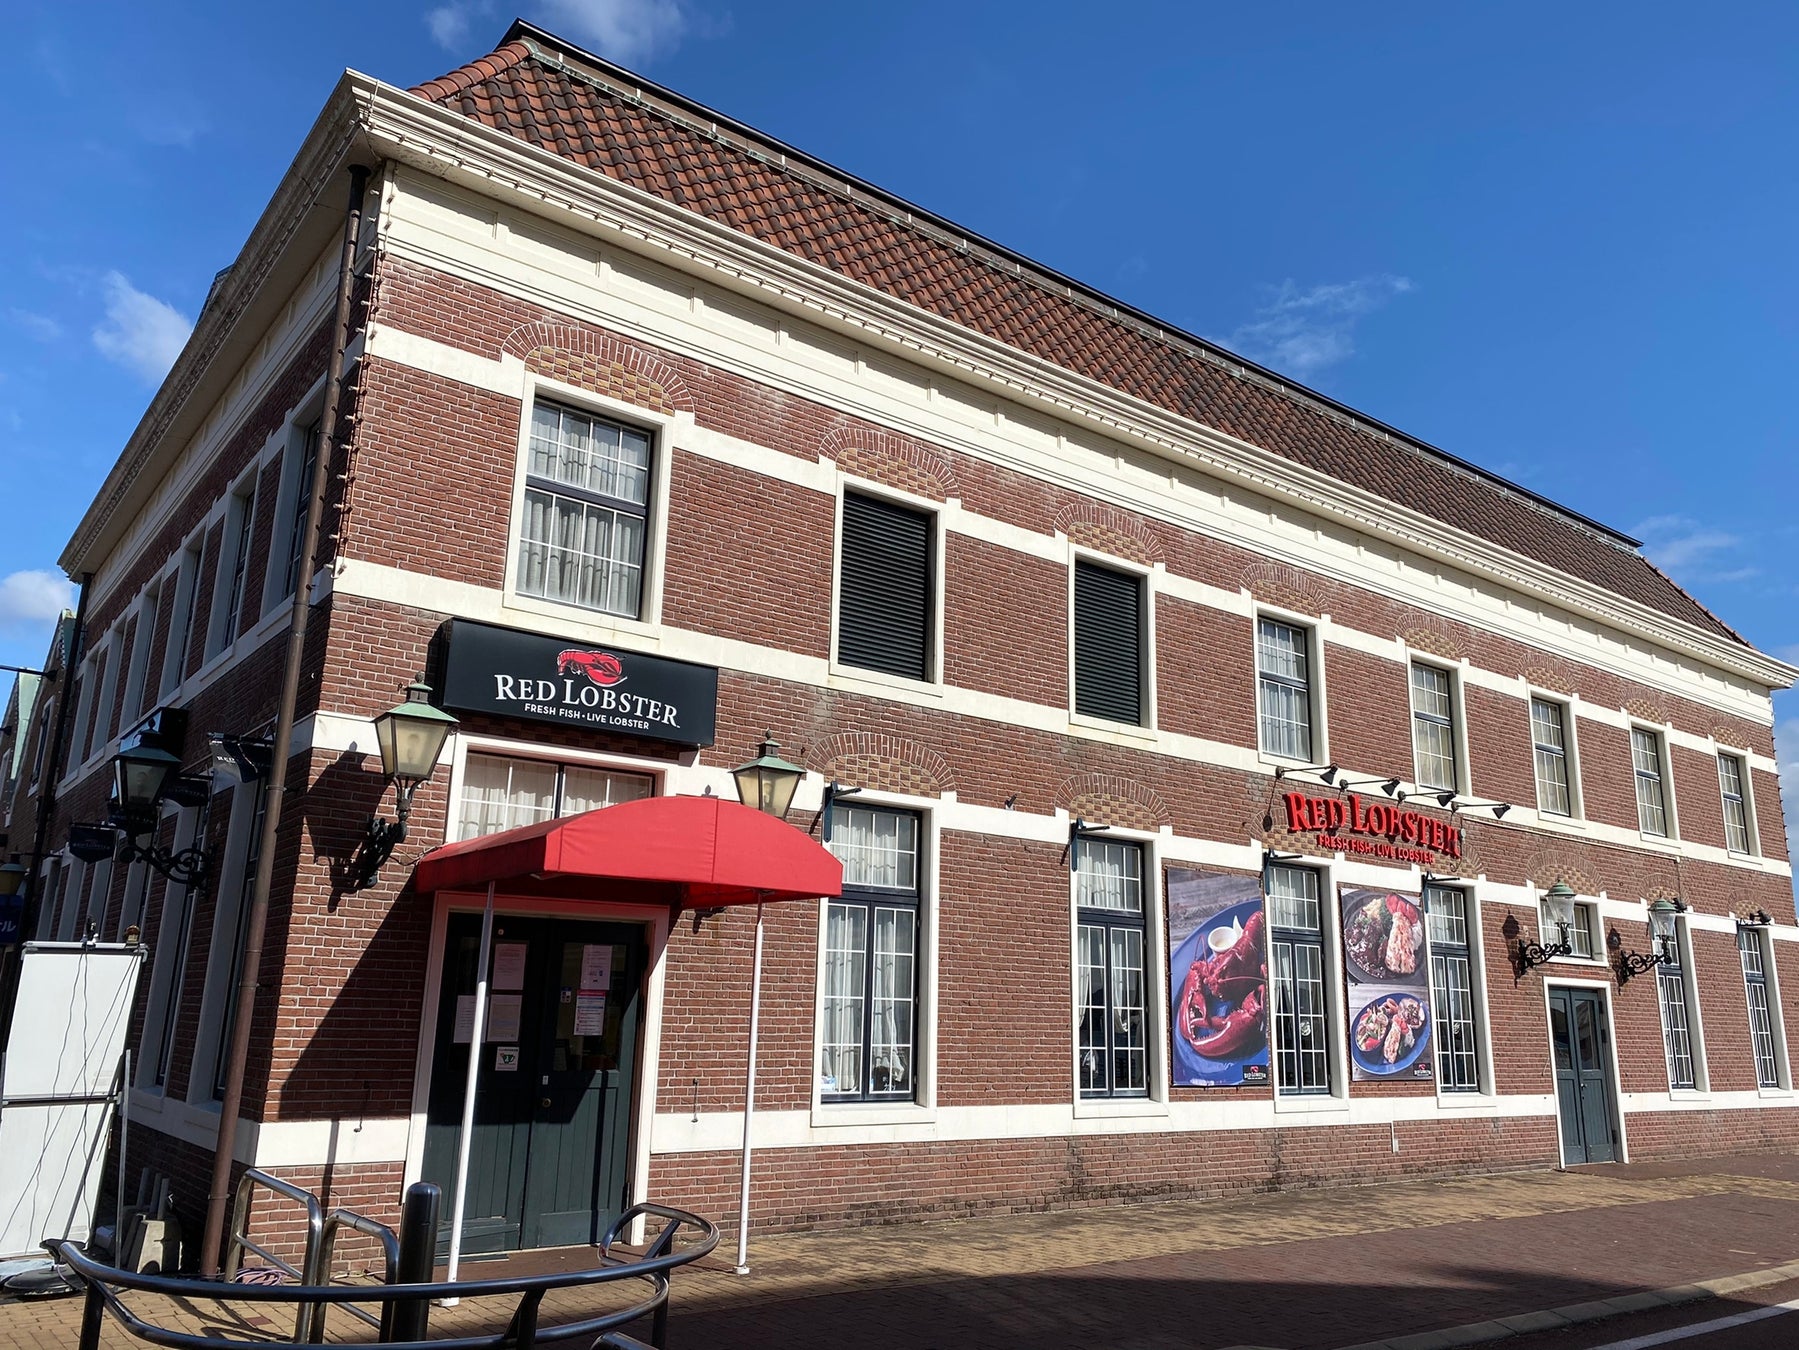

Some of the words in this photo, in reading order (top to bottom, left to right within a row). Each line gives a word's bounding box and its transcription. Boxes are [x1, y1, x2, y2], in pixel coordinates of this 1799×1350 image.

[494, 674, 556, 700] RED
[562, 679, 678, 728] LOBSTER
[524, 703, 556, 716] FRESH
[559, 708, 581, 719] FISH
[586, 712, 607, 724] LIVE
[609, 716, 650, 730] LOBSTER
[1283, 792, 1347, 833] RED
[1348, 794, 1461, 859] LOBSTER
[1317, 834, 1349, 851] FRESH
[1350, 840, 1372, 854] FISH
[1375, 844, 1395, 859] LIVE
[1396, 847, 1436, 864] LOBSTER
